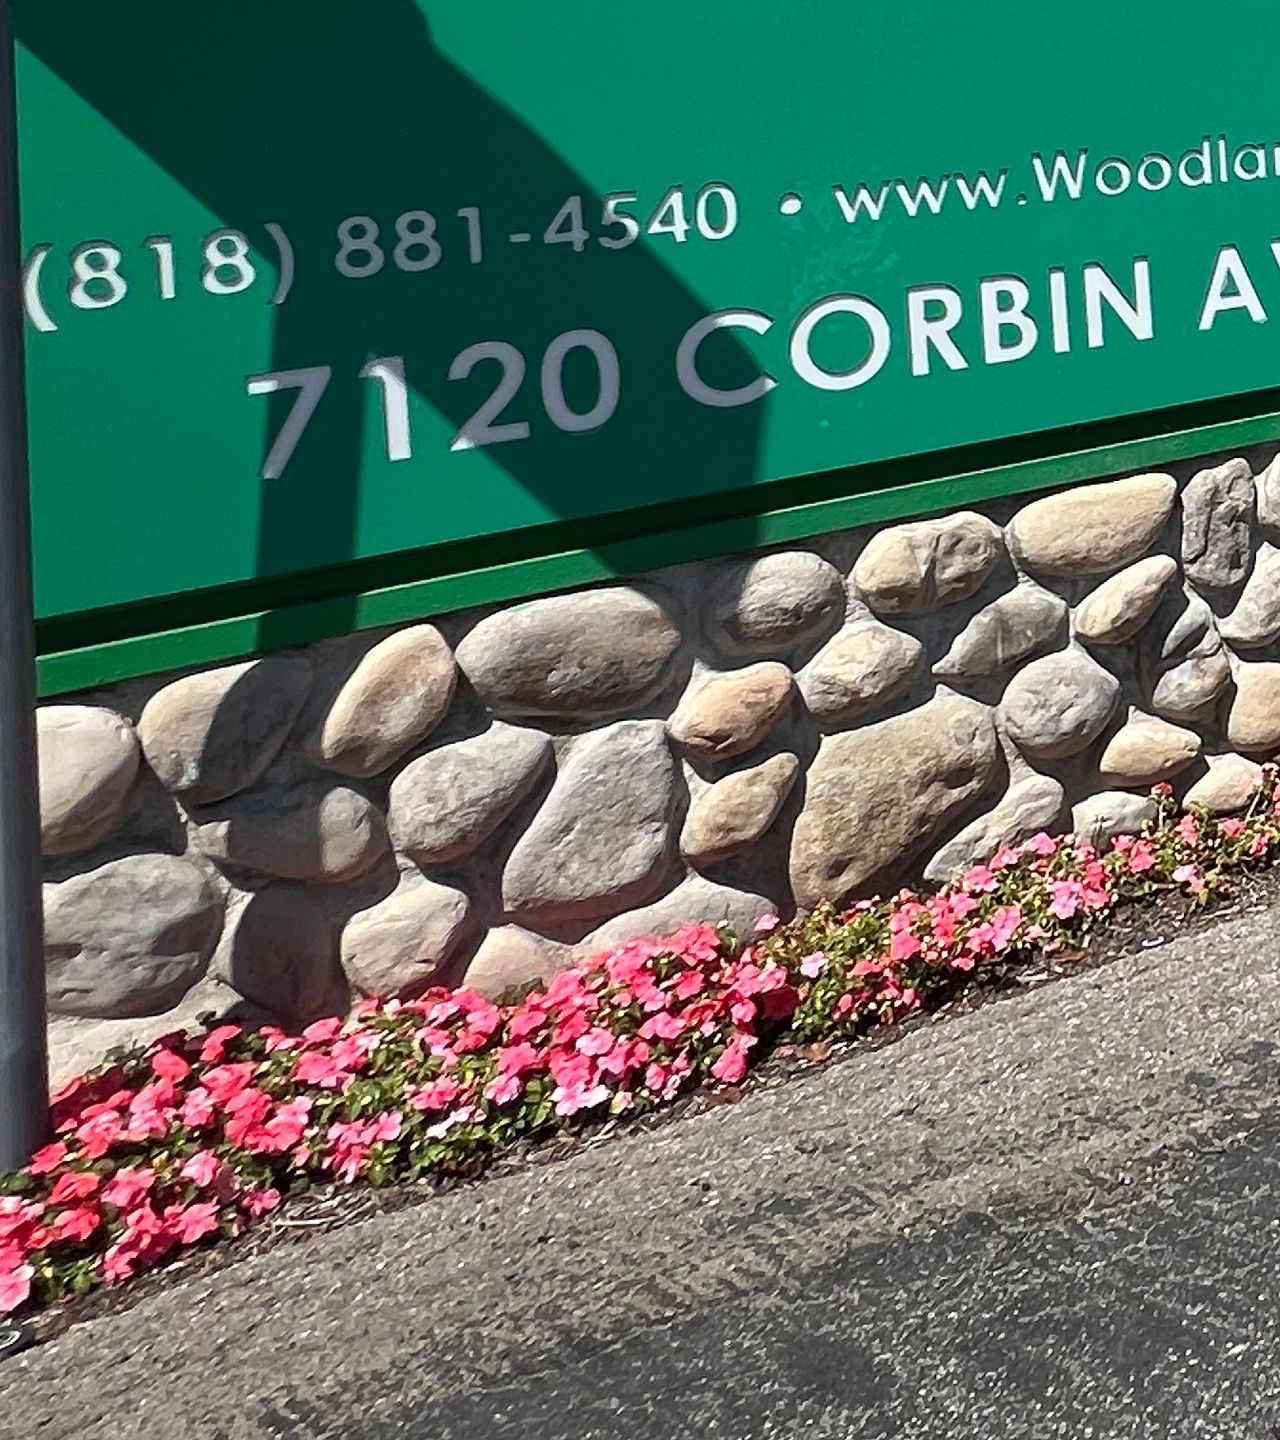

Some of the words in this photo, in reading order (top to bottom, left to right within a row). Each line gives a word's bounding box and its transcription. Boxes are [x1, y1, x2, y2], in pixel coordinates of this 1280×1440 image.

[22, 222, 295, 332] (818)
[334, 180, 739, 279] 881-4540
[246, 328, 621, 481] 7120
[674, 255, 1154, 408] CORBIN
